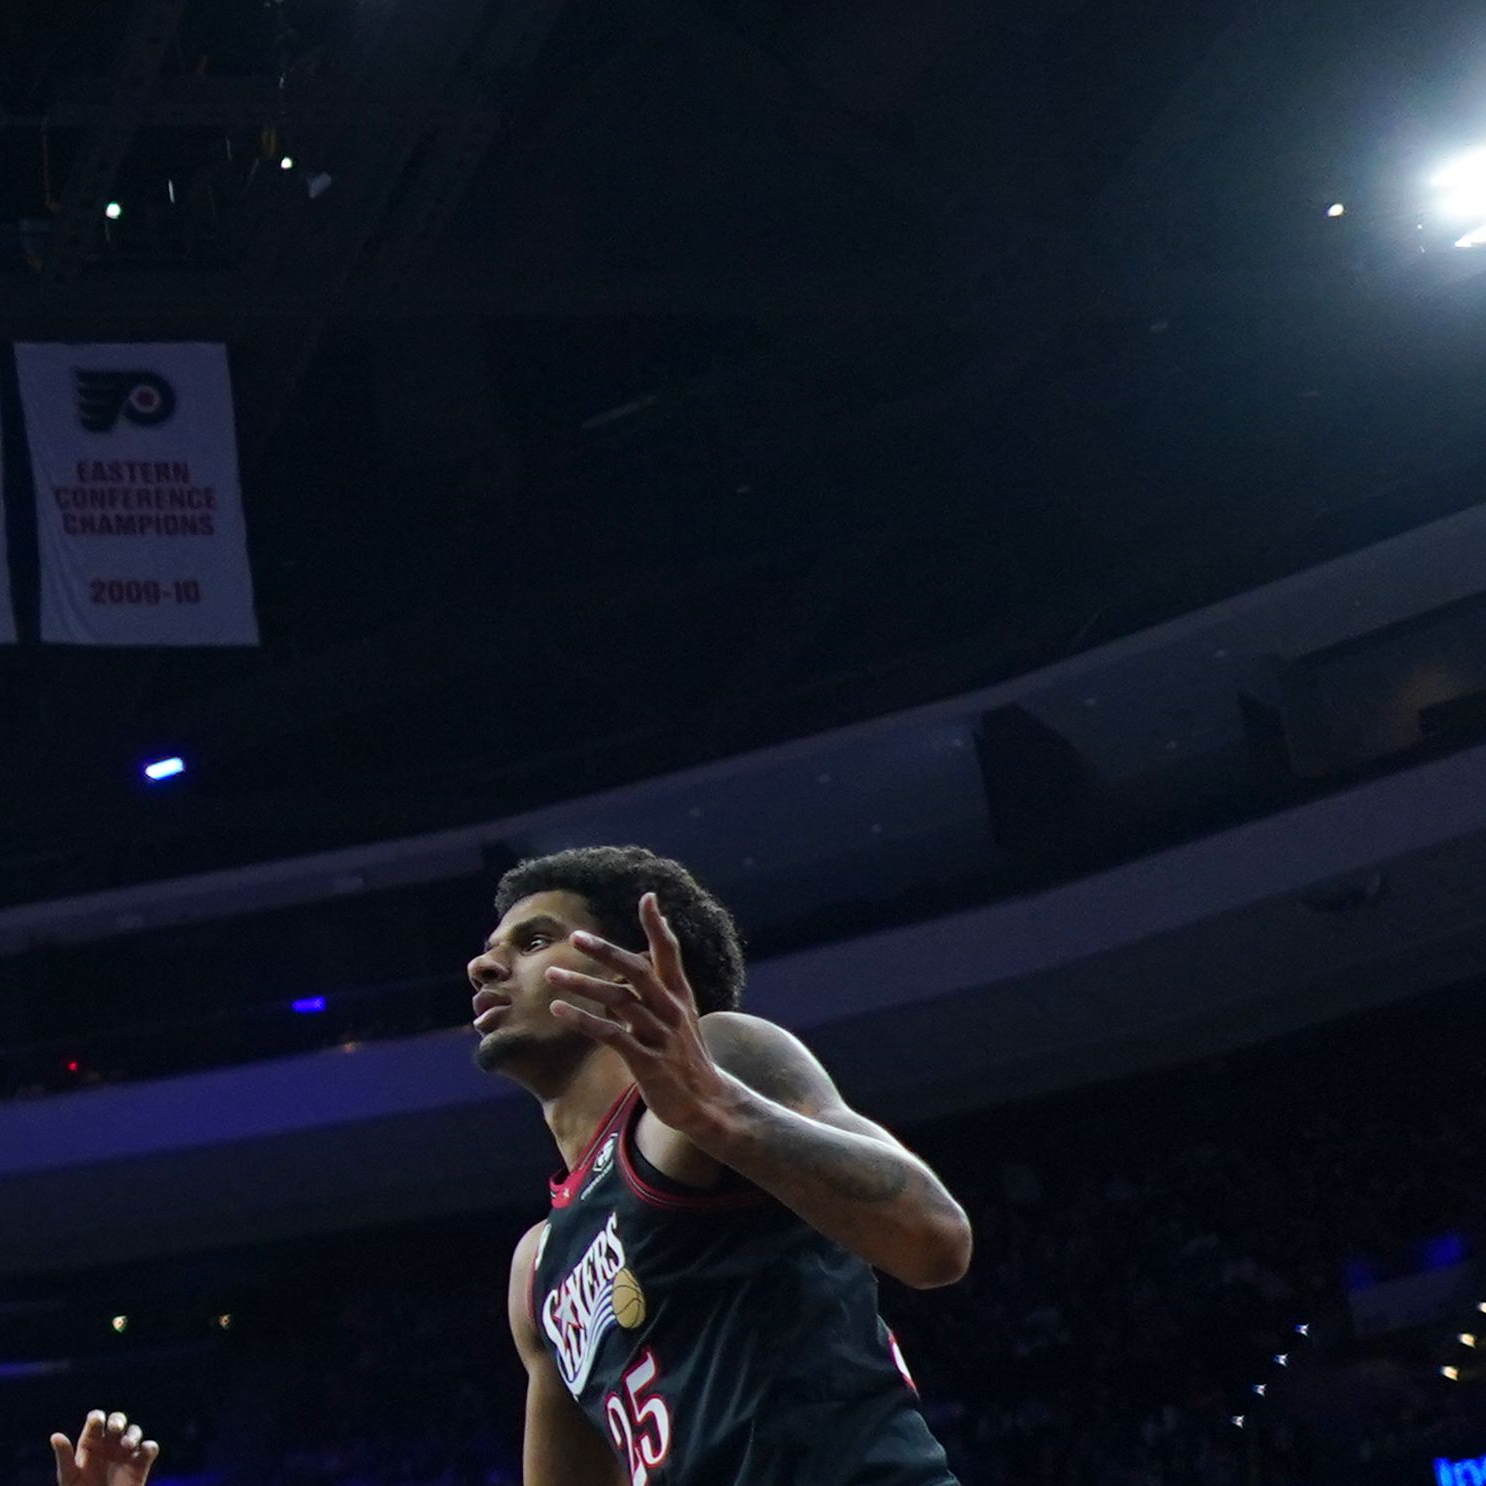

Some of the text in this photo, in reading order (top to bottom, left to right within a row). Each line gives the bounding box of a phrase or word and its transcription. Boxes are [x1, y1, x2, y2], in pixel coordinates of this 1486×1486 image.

[75, 459, 191, 485] EASTERN
[54, 487, 218, 512] CONFERENCE
[63, 512, 215, 537] CHAMPIONS
